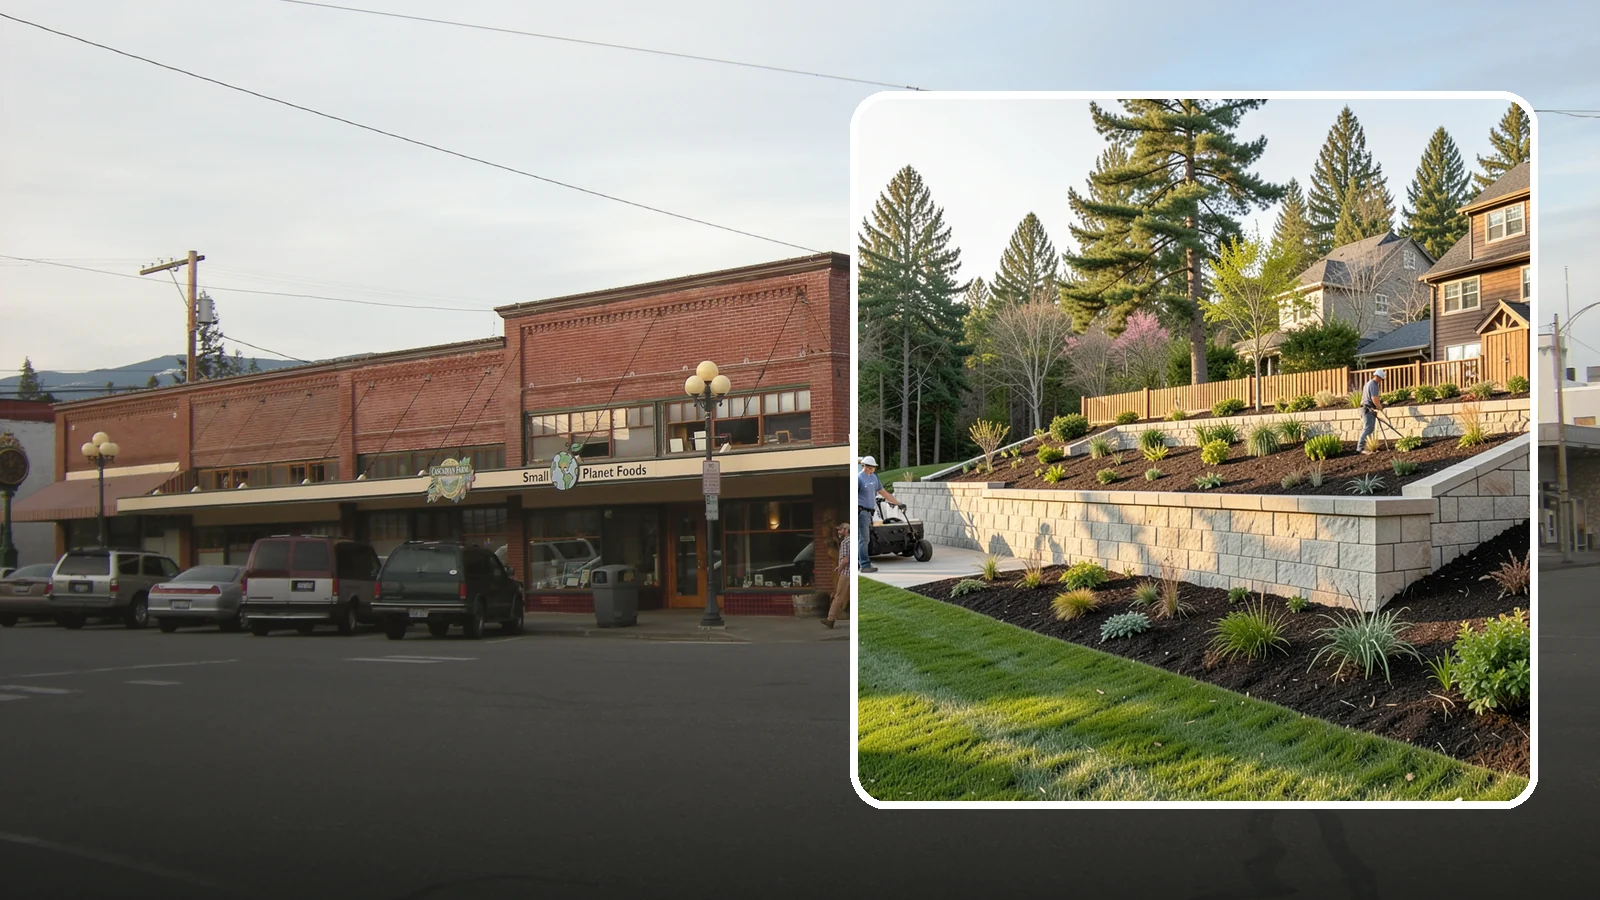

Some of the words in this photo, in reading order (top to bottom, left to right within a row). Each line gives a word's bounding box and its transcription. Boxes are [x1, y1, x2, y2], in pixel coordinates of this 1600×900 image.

[523, 471, 549, 483] Small
[583, 467, 614, 479] Planet
[617, 464, 647, 477] Foods
